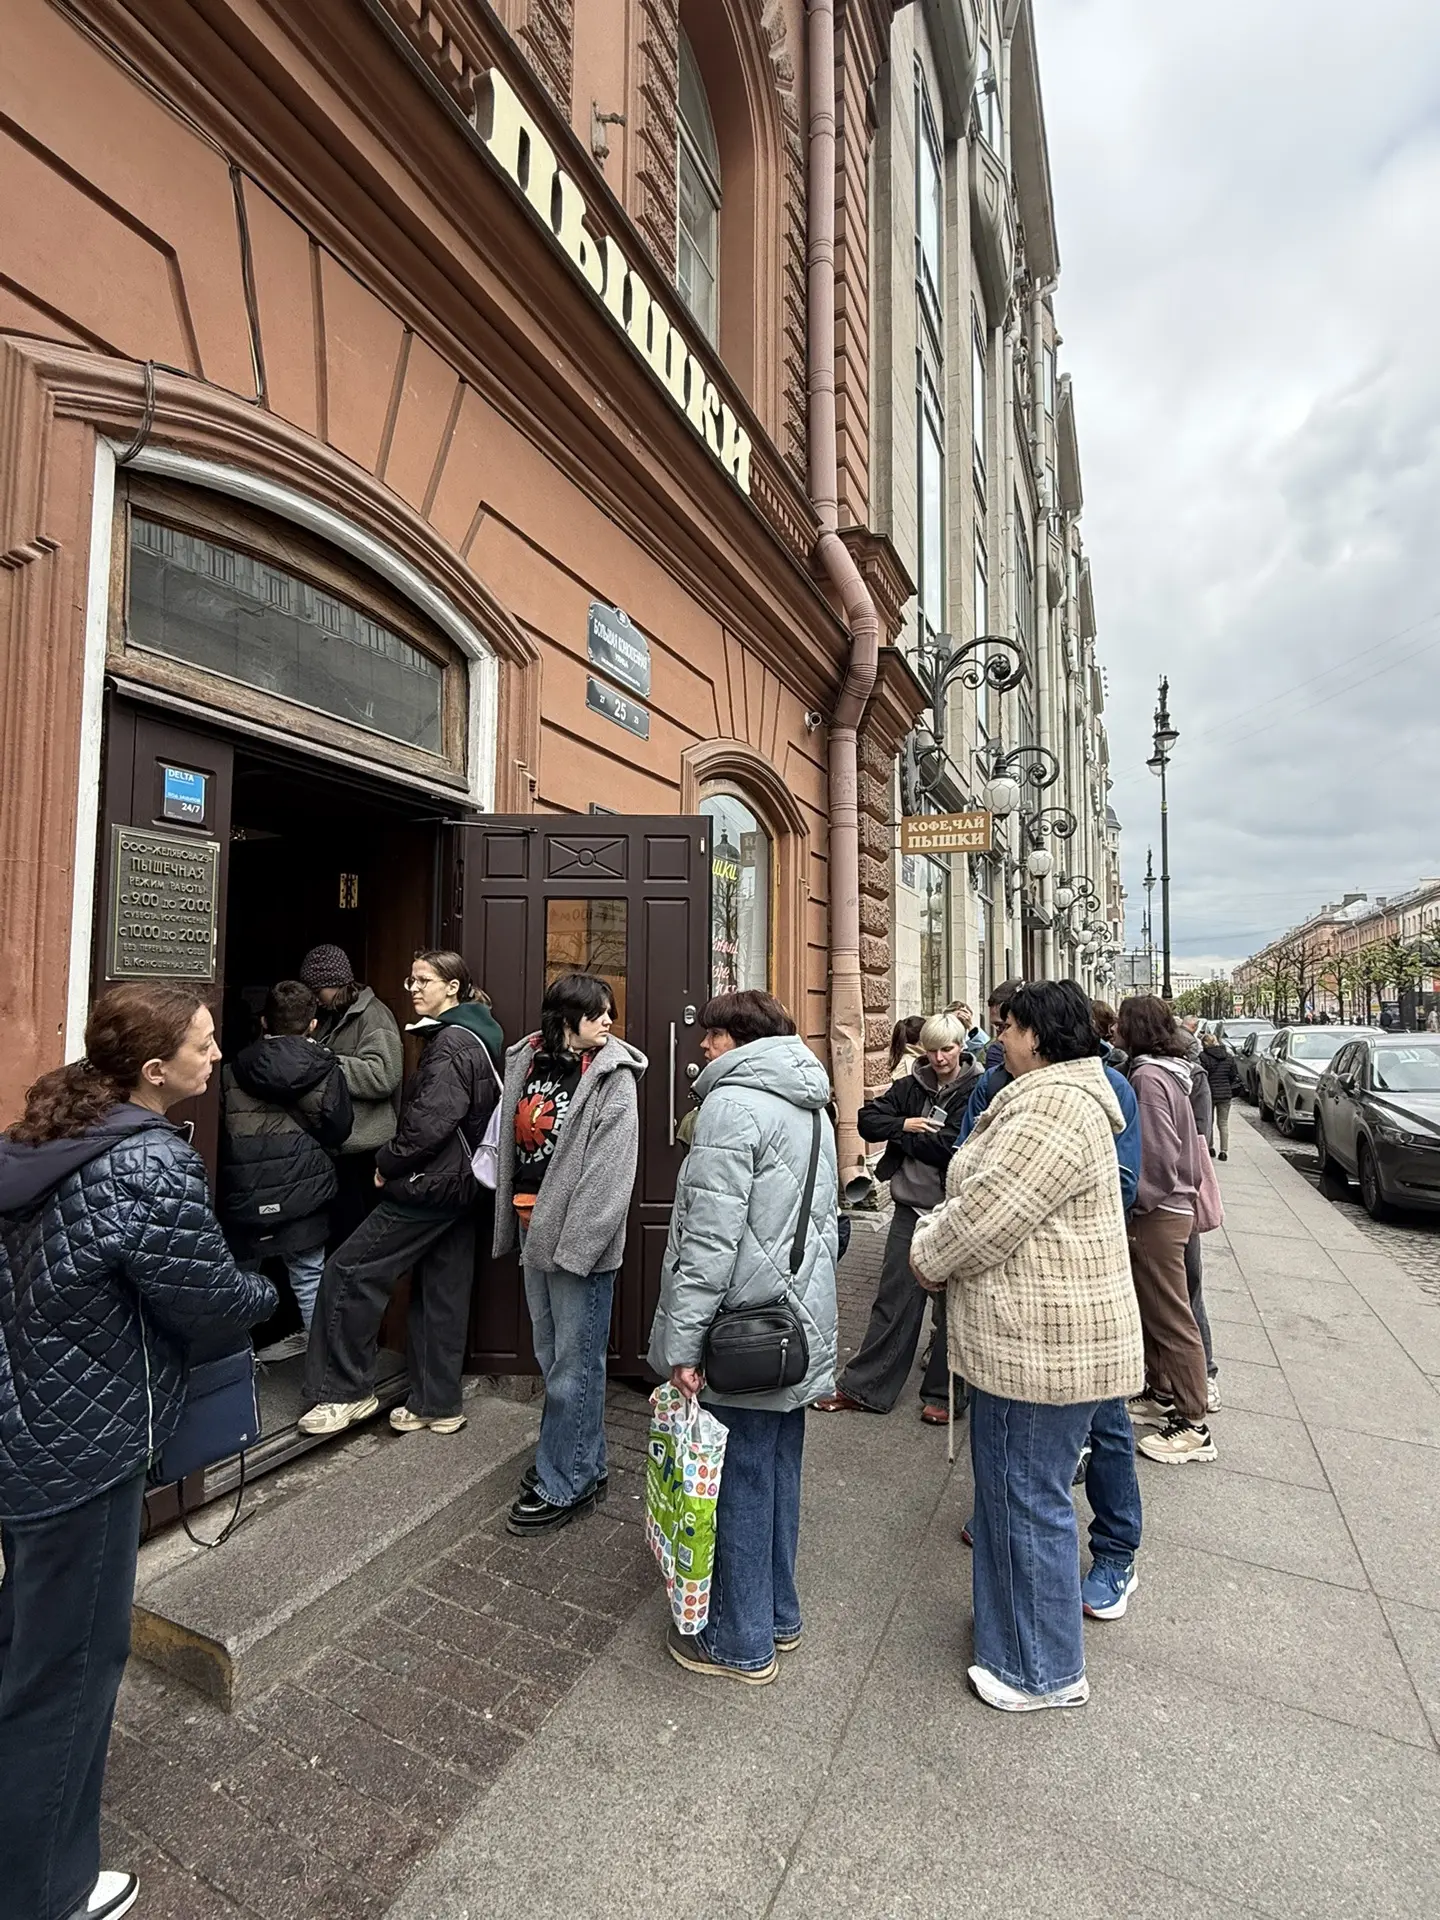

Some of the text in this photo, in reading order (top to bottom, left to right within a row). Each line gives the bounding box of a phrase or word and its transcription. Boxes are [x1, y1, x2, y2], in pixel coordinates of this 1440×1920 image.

[473, 67, 751, 495] ПЫШКИ
[614, 699, 627, 721] 25
[168, 769, 195, 782] DELTA
[181, 802, 201, 813] 24/7
[907, 832, 985, 848] ПЫШКИ
[131, 856, 205, 880] ПЫШЕЧНАЯ
[129, 876, 165, 890] РЕЖИМ
[131, 891, 159, 907] 9.00
[162, 899, 177, 909] до
[180, 897, 212, 912] 20.00
[128, 924, 160, 938] 10.00
[162, 930, 177, 940] до
[179, 928, 211, 943] 20.00
[527, 1080, 561, 1095] HOT
